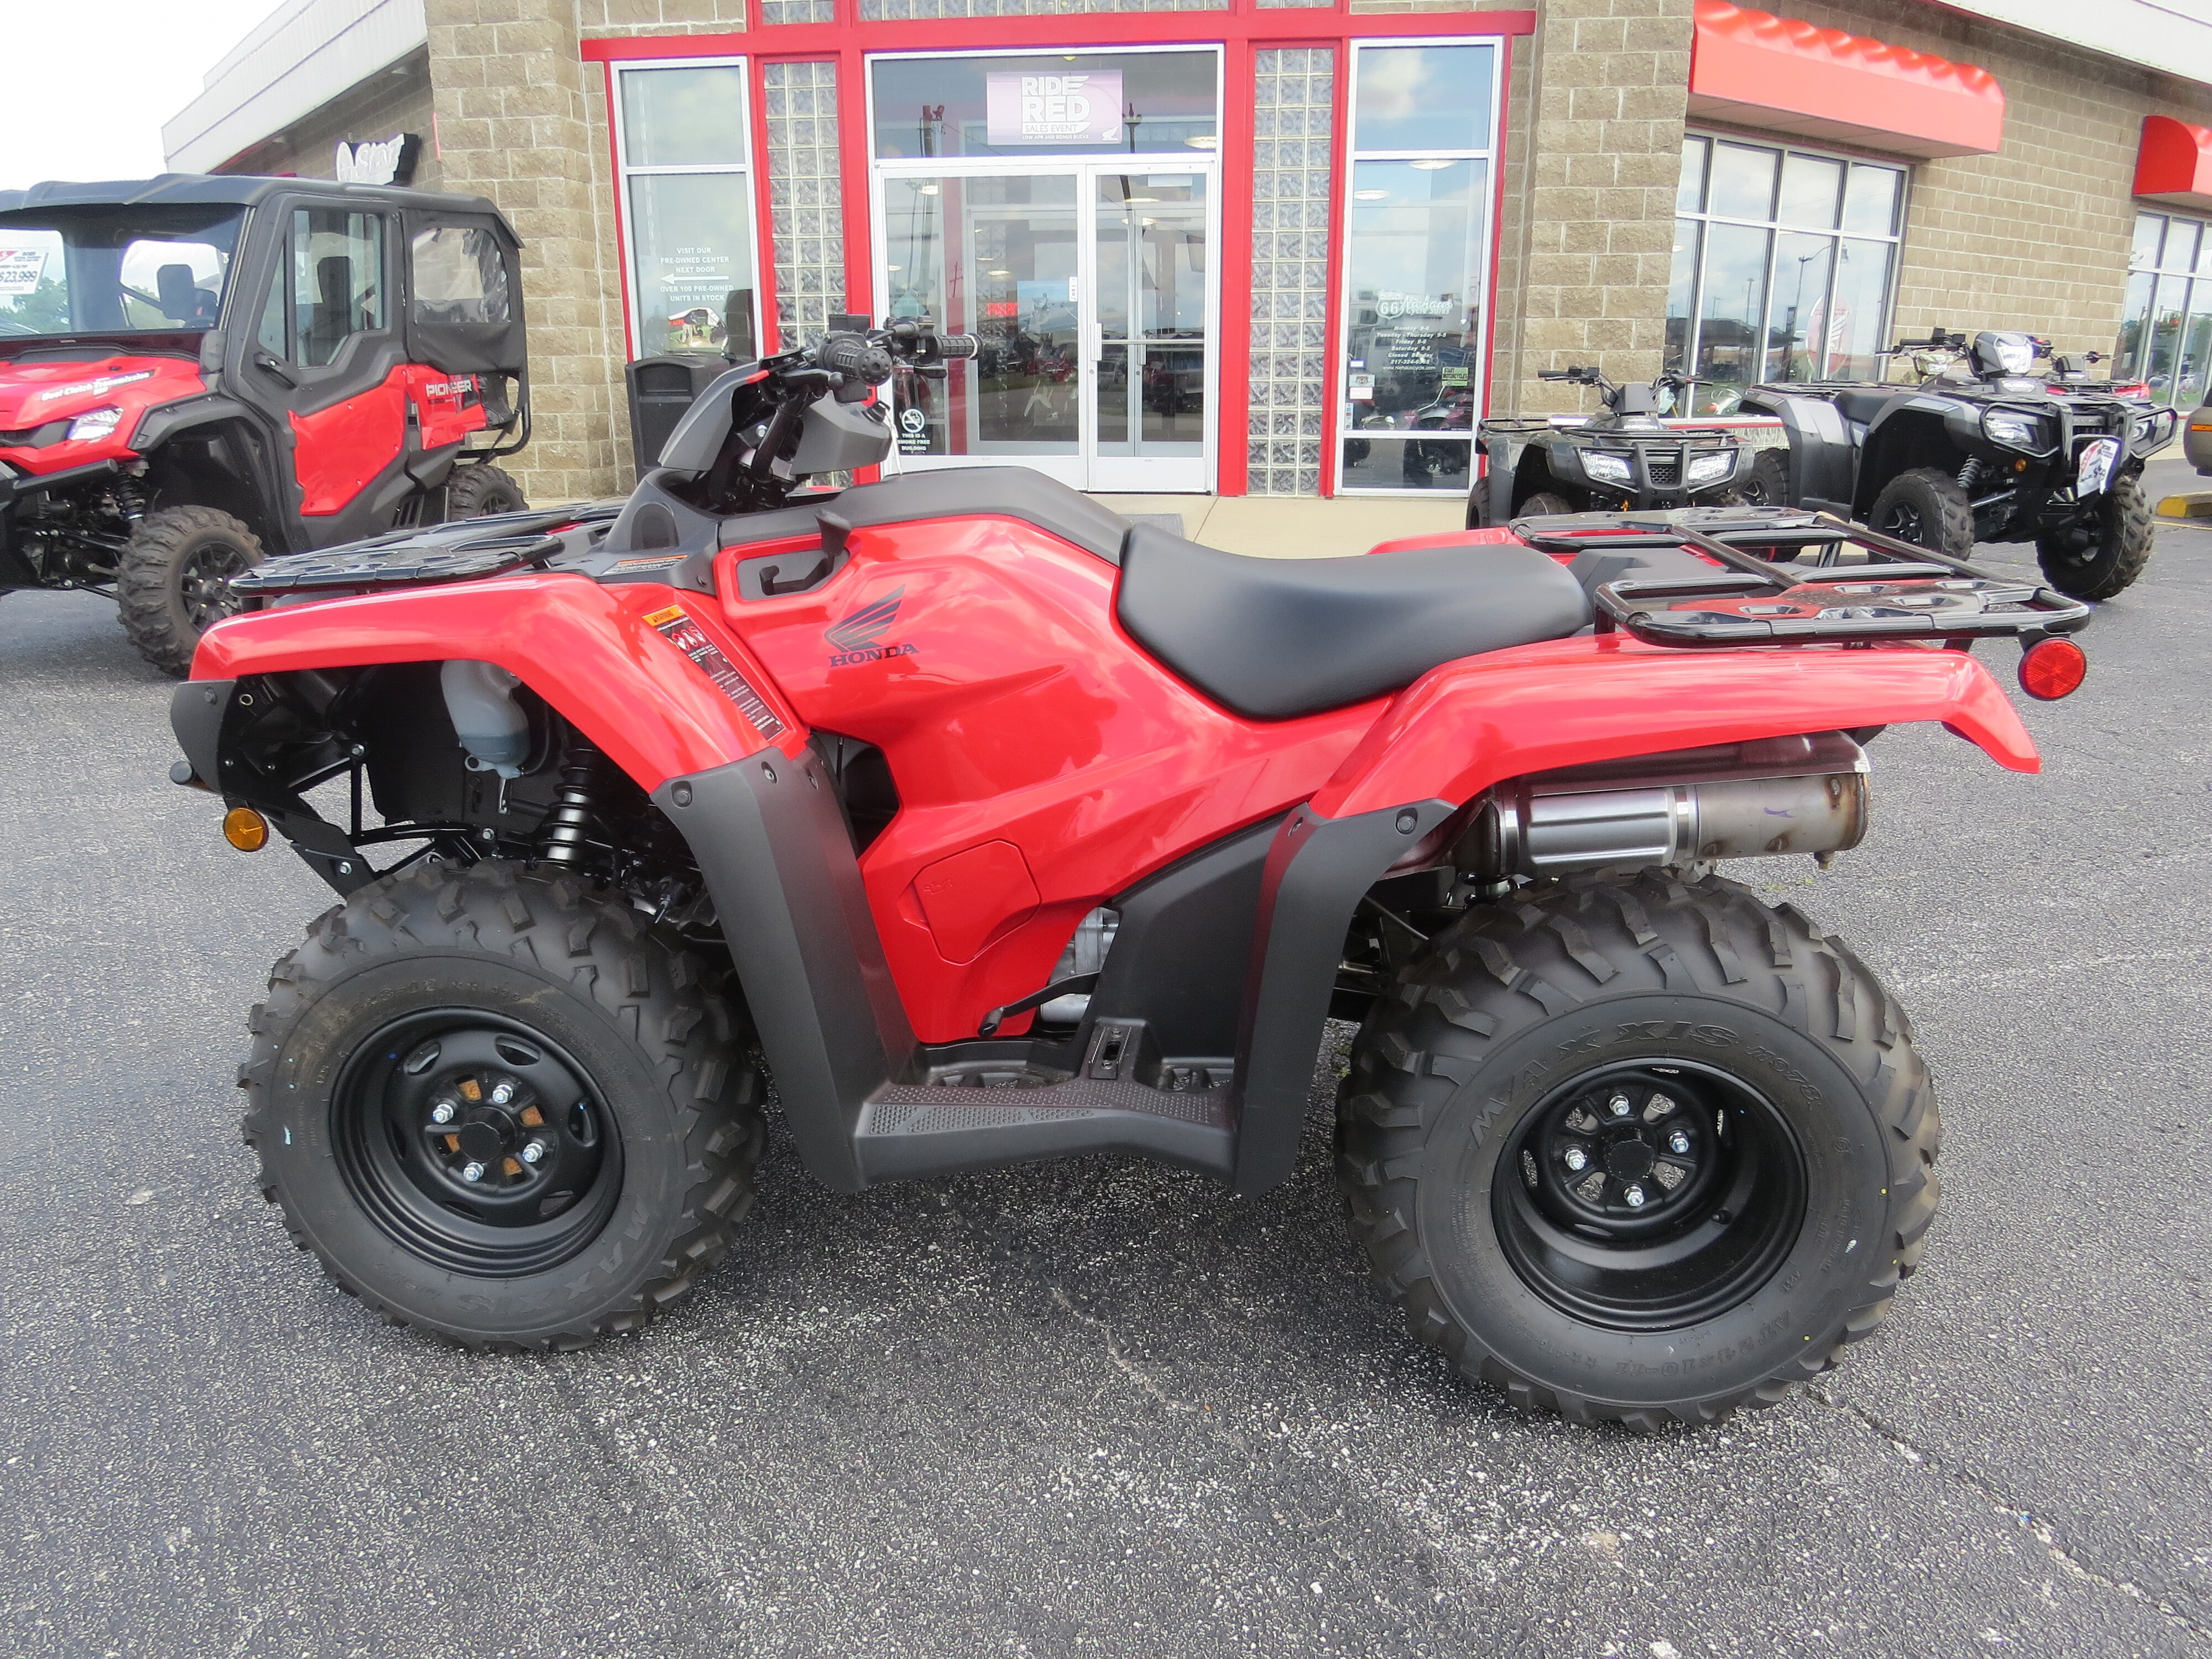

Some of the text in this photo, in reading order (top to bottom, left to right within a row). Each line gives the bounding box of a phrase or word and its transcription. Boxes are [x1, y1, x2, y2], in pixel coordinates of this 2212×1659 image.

[1021, 76, 1090, 96] RIDE
[1022, 96, 1091, 122] RED
[1025, 124, 1078, 133] SALES EVENT
[1381, 301, 1399, 314] 66
[41, 389, 62, 401] Dual
[64, 384, 92, 395] Clutch
[828, 644, 920, 667] HONDA
[1469, 1020, 1739, 1148] MAXXIS
[457, 1192, 650, 1314] MAXXIS
